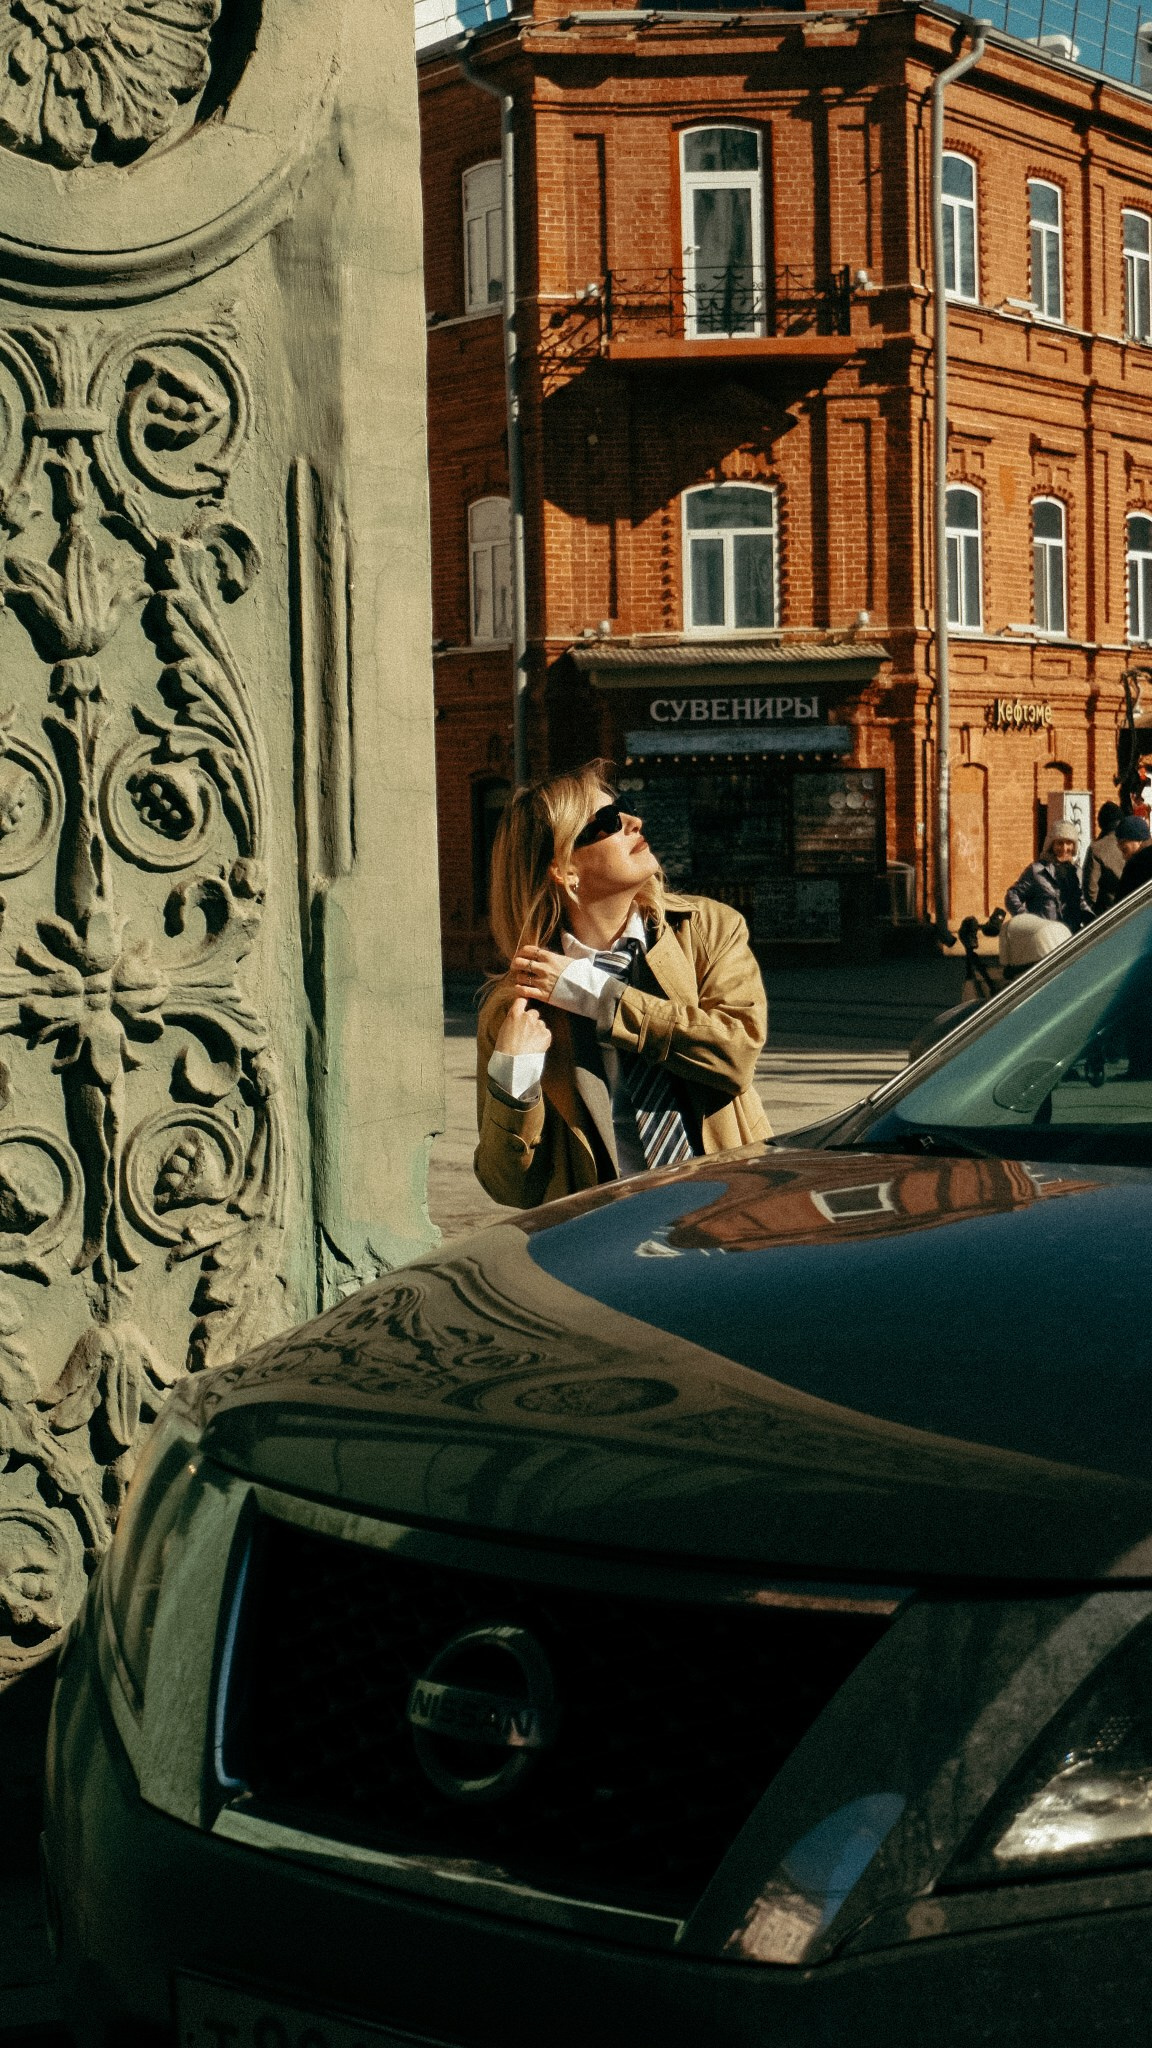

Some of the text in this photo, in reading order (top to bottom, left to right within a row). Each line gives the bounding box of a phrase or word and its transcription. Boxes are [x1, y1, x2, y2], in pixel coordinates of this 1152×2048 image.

[650, 697, 819, 722] СУВЕНИРЫ
[997, 699, 1052, 726] Кефтэме
[410, 1688, 535, 1736] NISSAN
